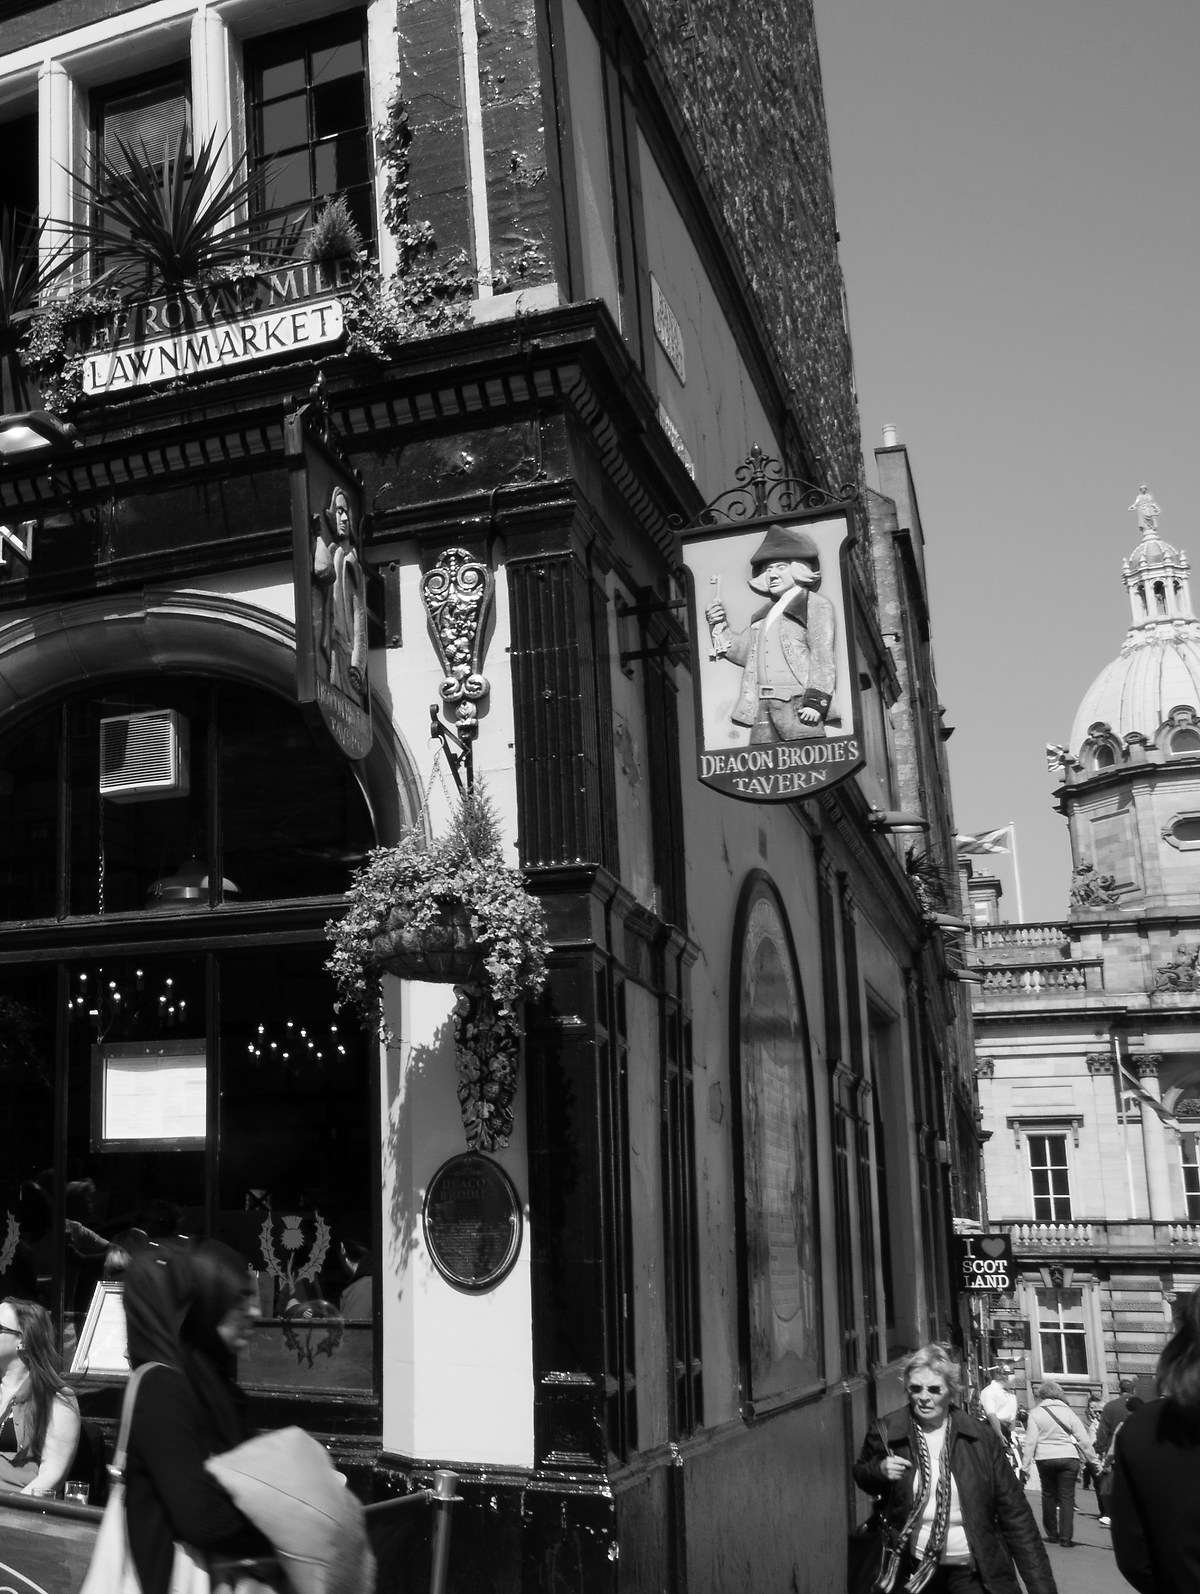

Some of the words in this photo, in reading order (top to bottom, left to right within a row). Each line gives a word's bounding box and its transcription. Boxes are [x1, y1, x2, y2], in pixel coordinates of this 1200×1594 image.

[89, 304, 333, 390] LAWNMARKET
[701, 751, 774, 778] DEACON
[776, 741, 860, 770] BRODIE'S
[732, 769, 828, 794] TAVERN
[962, 1238, 976, 1258] I
[962, 1260, 1007, 1273] SCOT
[964, 1275, 1010, 1289] LAND
